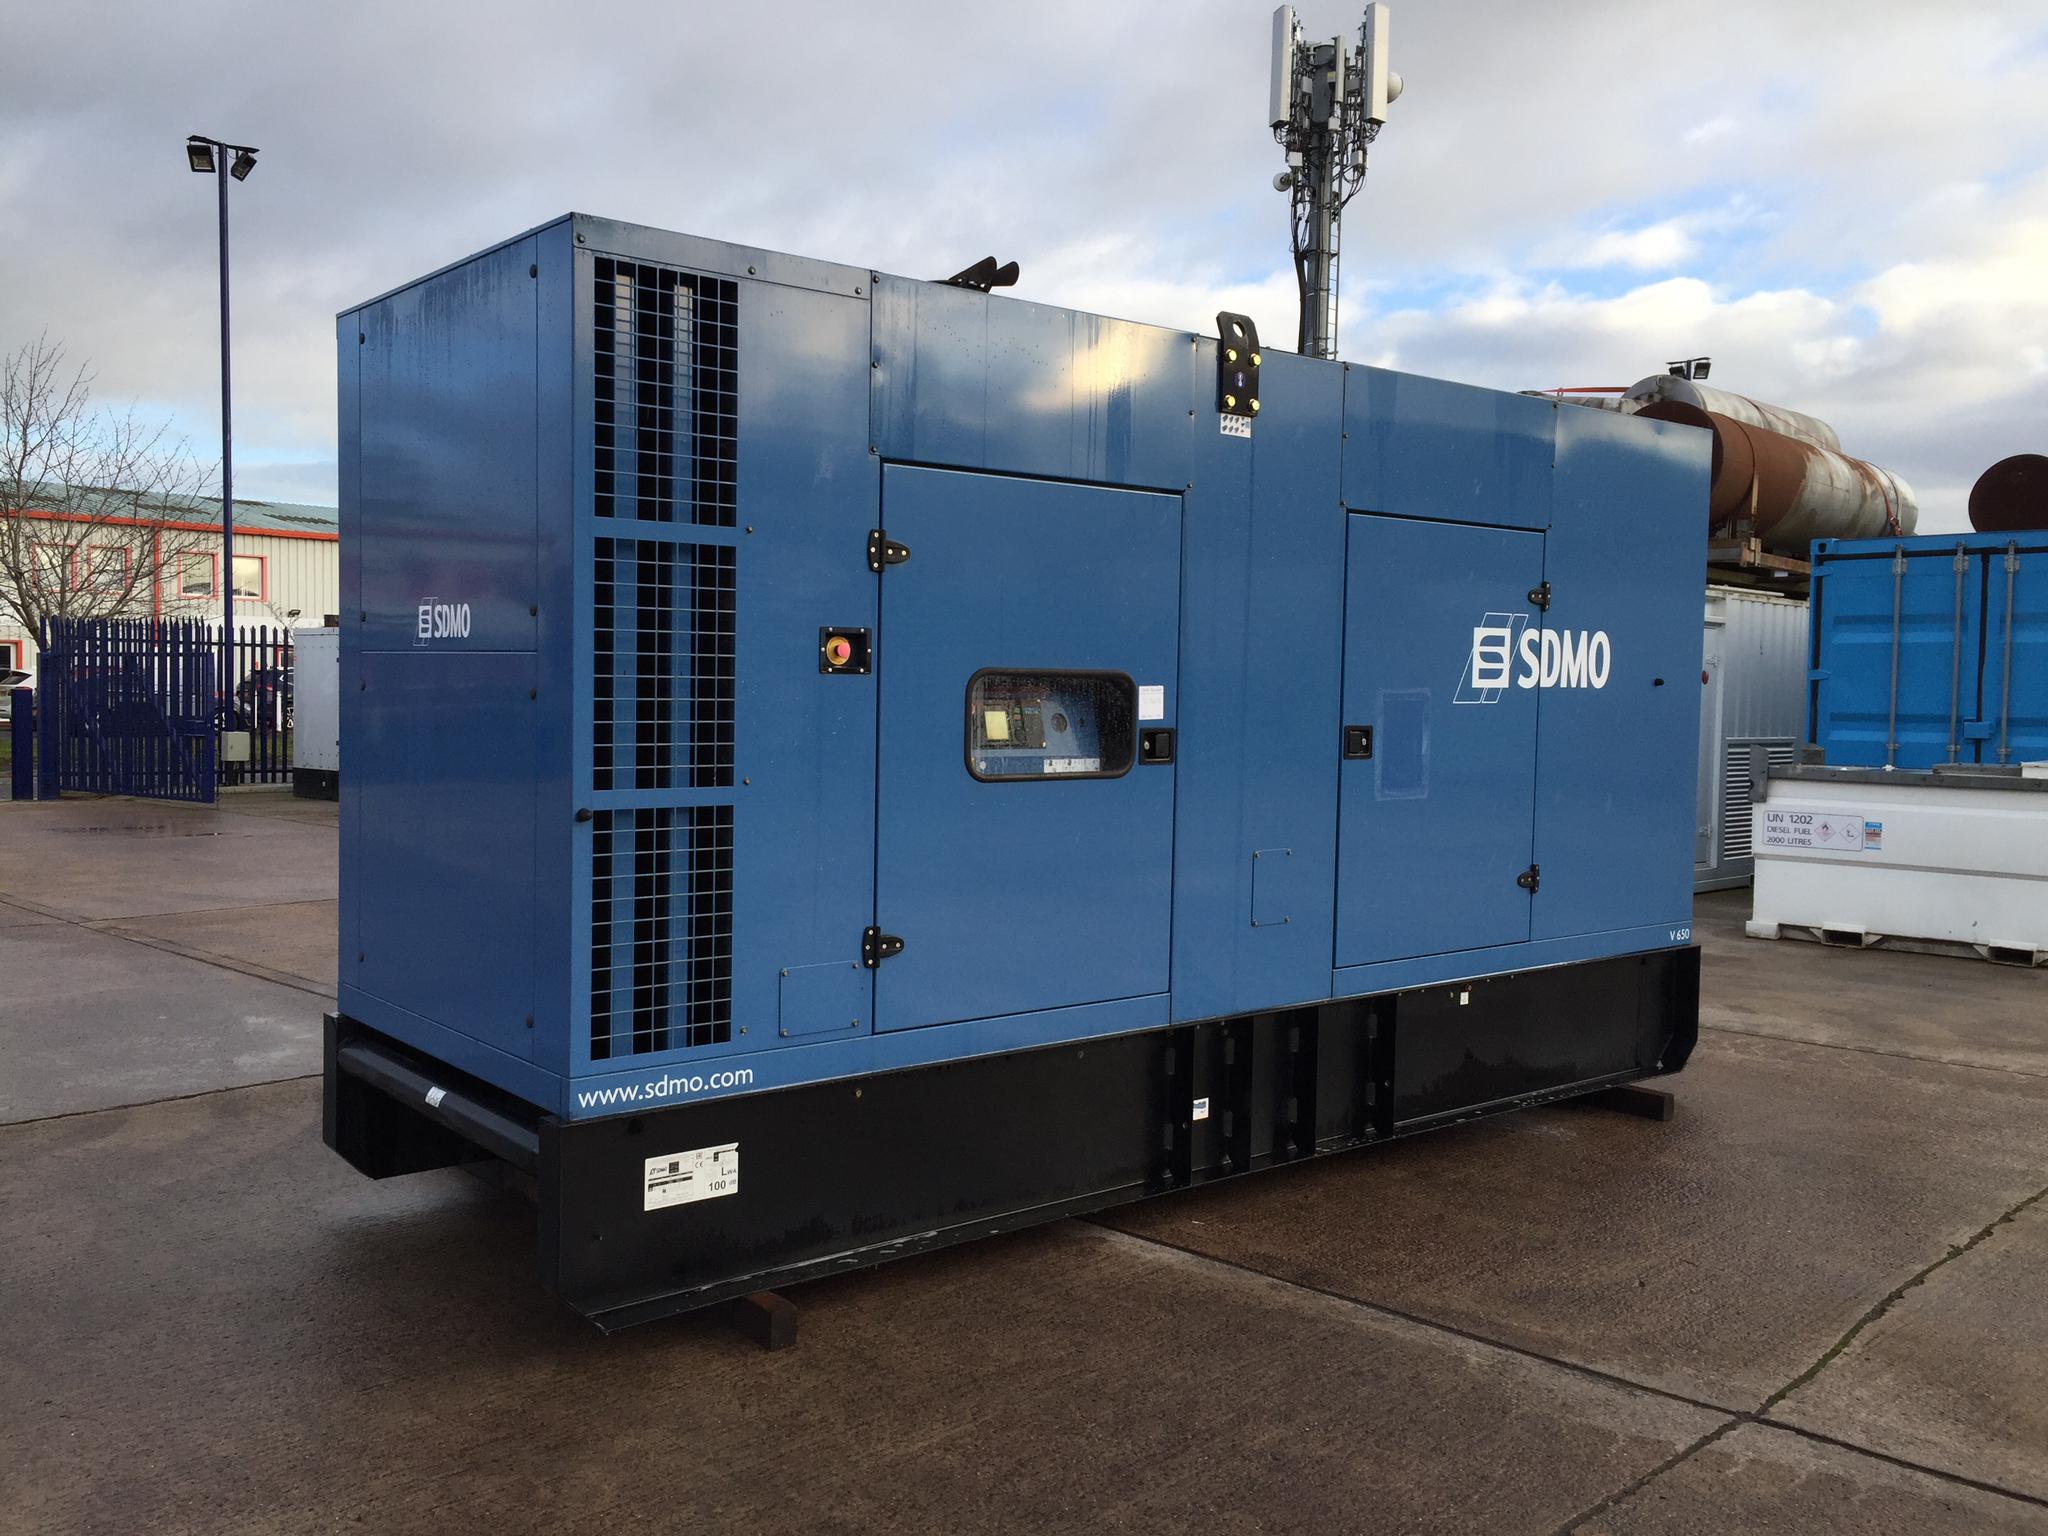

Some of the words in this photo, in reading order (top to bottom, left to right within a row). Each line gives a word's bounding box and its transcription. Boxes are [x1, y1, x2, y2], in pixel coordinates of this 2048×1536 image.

[434, 603, 471, 638] SDMO
[1517, 628, 1611, 689] SDMO
[1767, 813, 1784, 823] UN
[1789, 814, 1813, 825] 1202
[1767, 825, 1791, 834] DIESEL
[1794, 827, 1812, 835] FUEL
[1767, 836, 1785, 844] 2000
[1788, 837, 1812, 846] LITRES
[1669, 930, 1676, 941] V
[1676, 928, 1690, 940] 650
[578, 1068, 753, 1108] www.sdmo.com
[708, 1179, 727, 1192] 100
